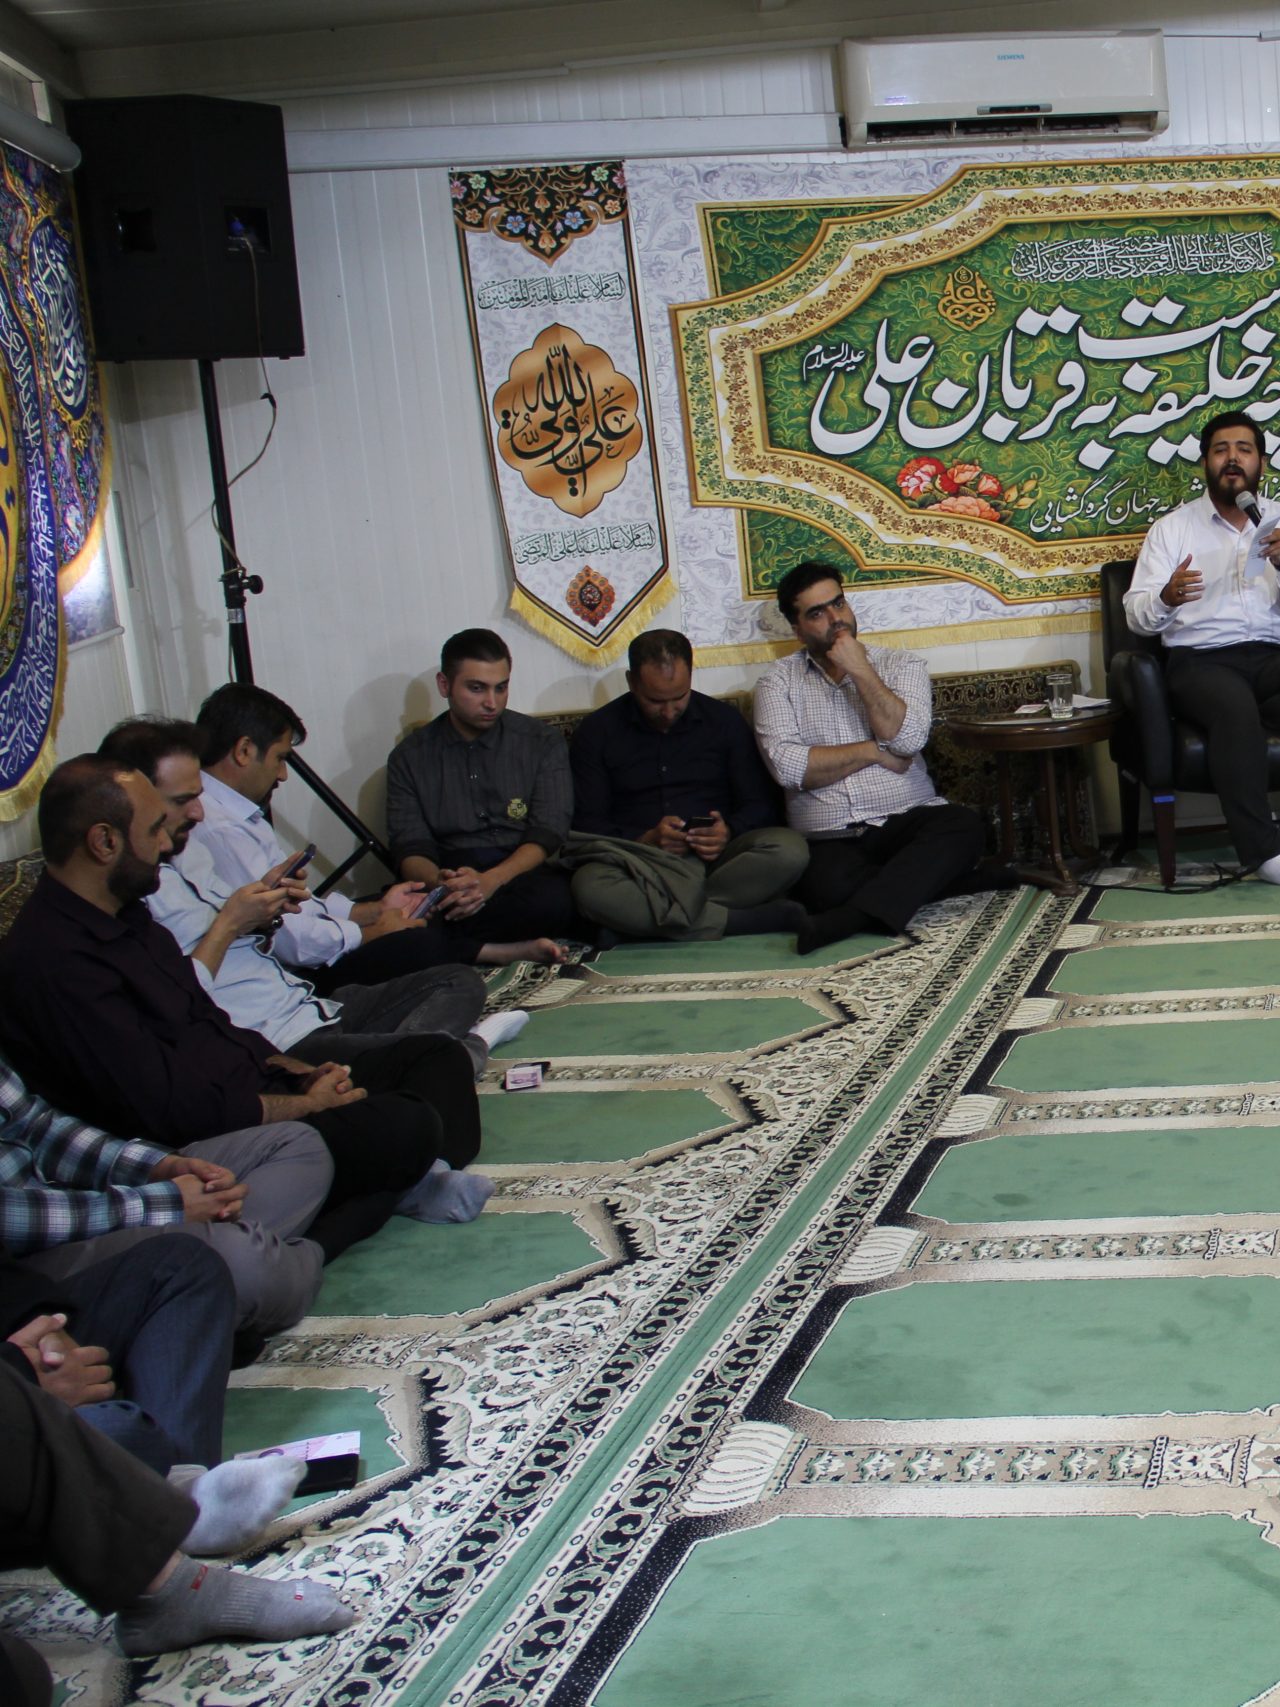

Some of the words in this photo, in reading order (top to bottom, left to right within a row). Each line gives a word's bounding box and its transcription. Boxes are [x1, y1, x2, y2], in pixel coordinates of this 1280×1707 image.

[810, 318, 935, 455] علی
[898, 305, 1086, 449] قربان
[1071, 396, 1117, 471] به
